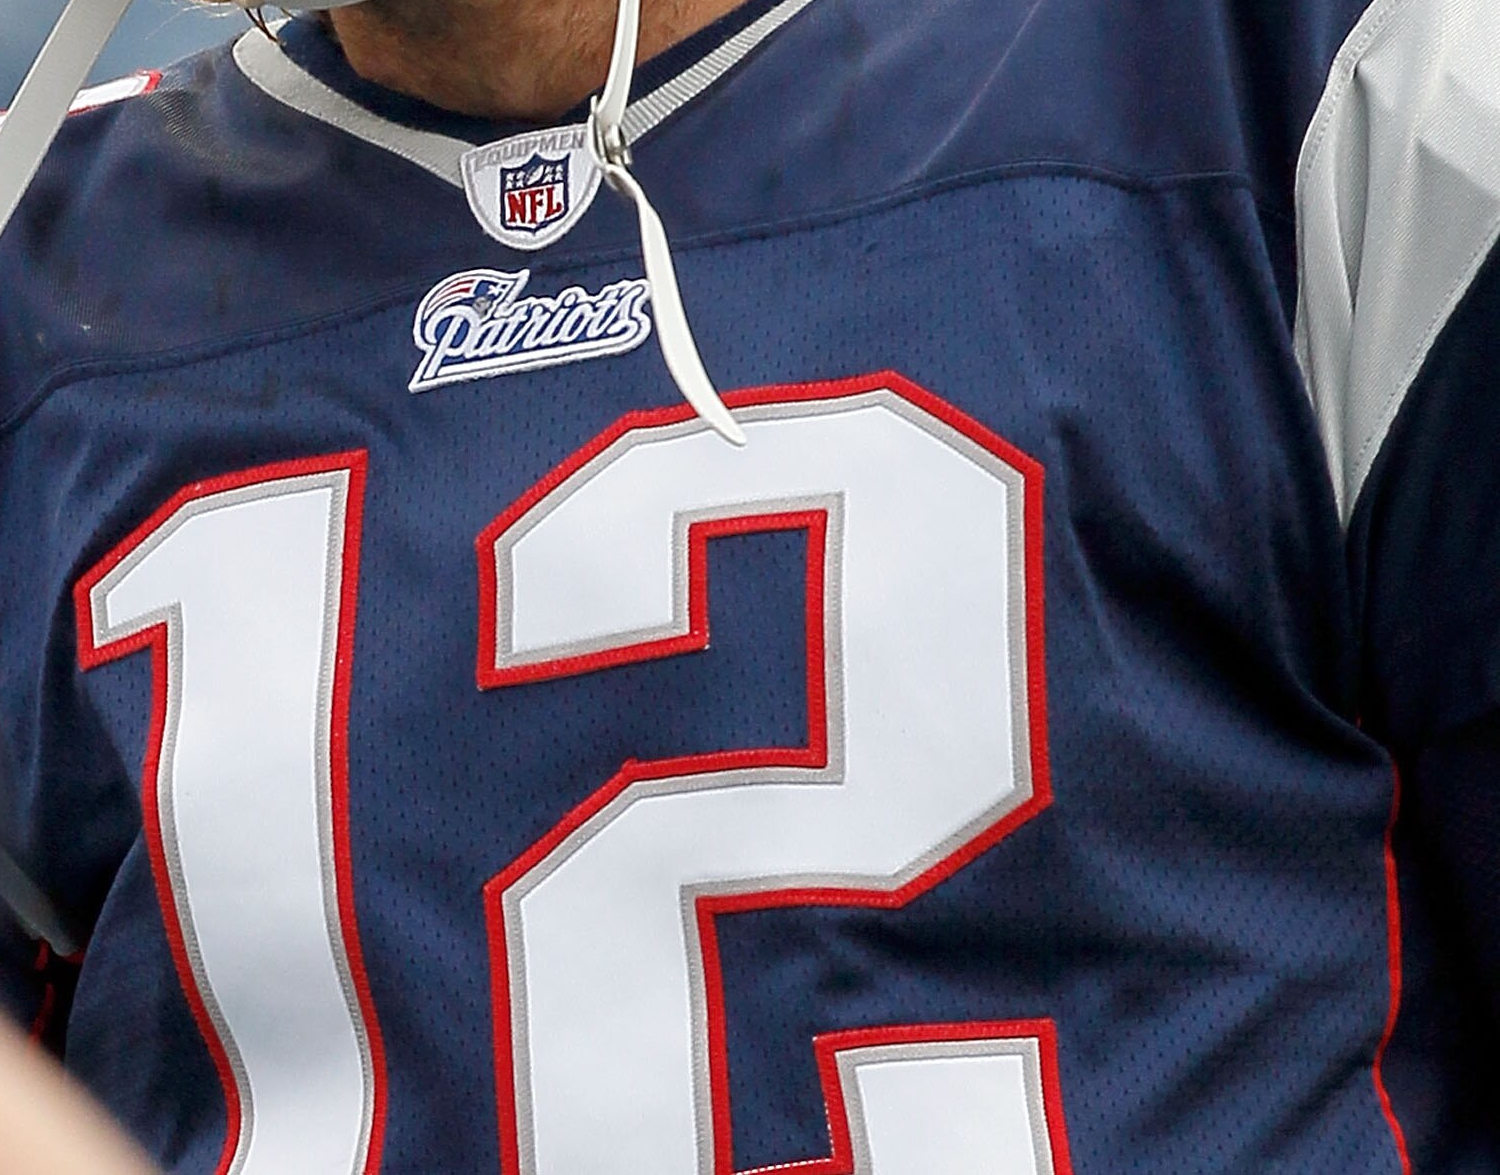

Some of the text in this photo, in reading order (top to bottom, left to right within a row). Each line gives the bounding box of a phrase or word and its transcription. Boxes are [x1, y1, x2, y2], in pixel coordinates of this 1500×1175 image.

[473, 130, 586, 173] EQUIPMEN
[506, 186, 563, 224] NFL
[410, 277, 651, 392] Patriots
[73, 372, 1070, 1175] 12
